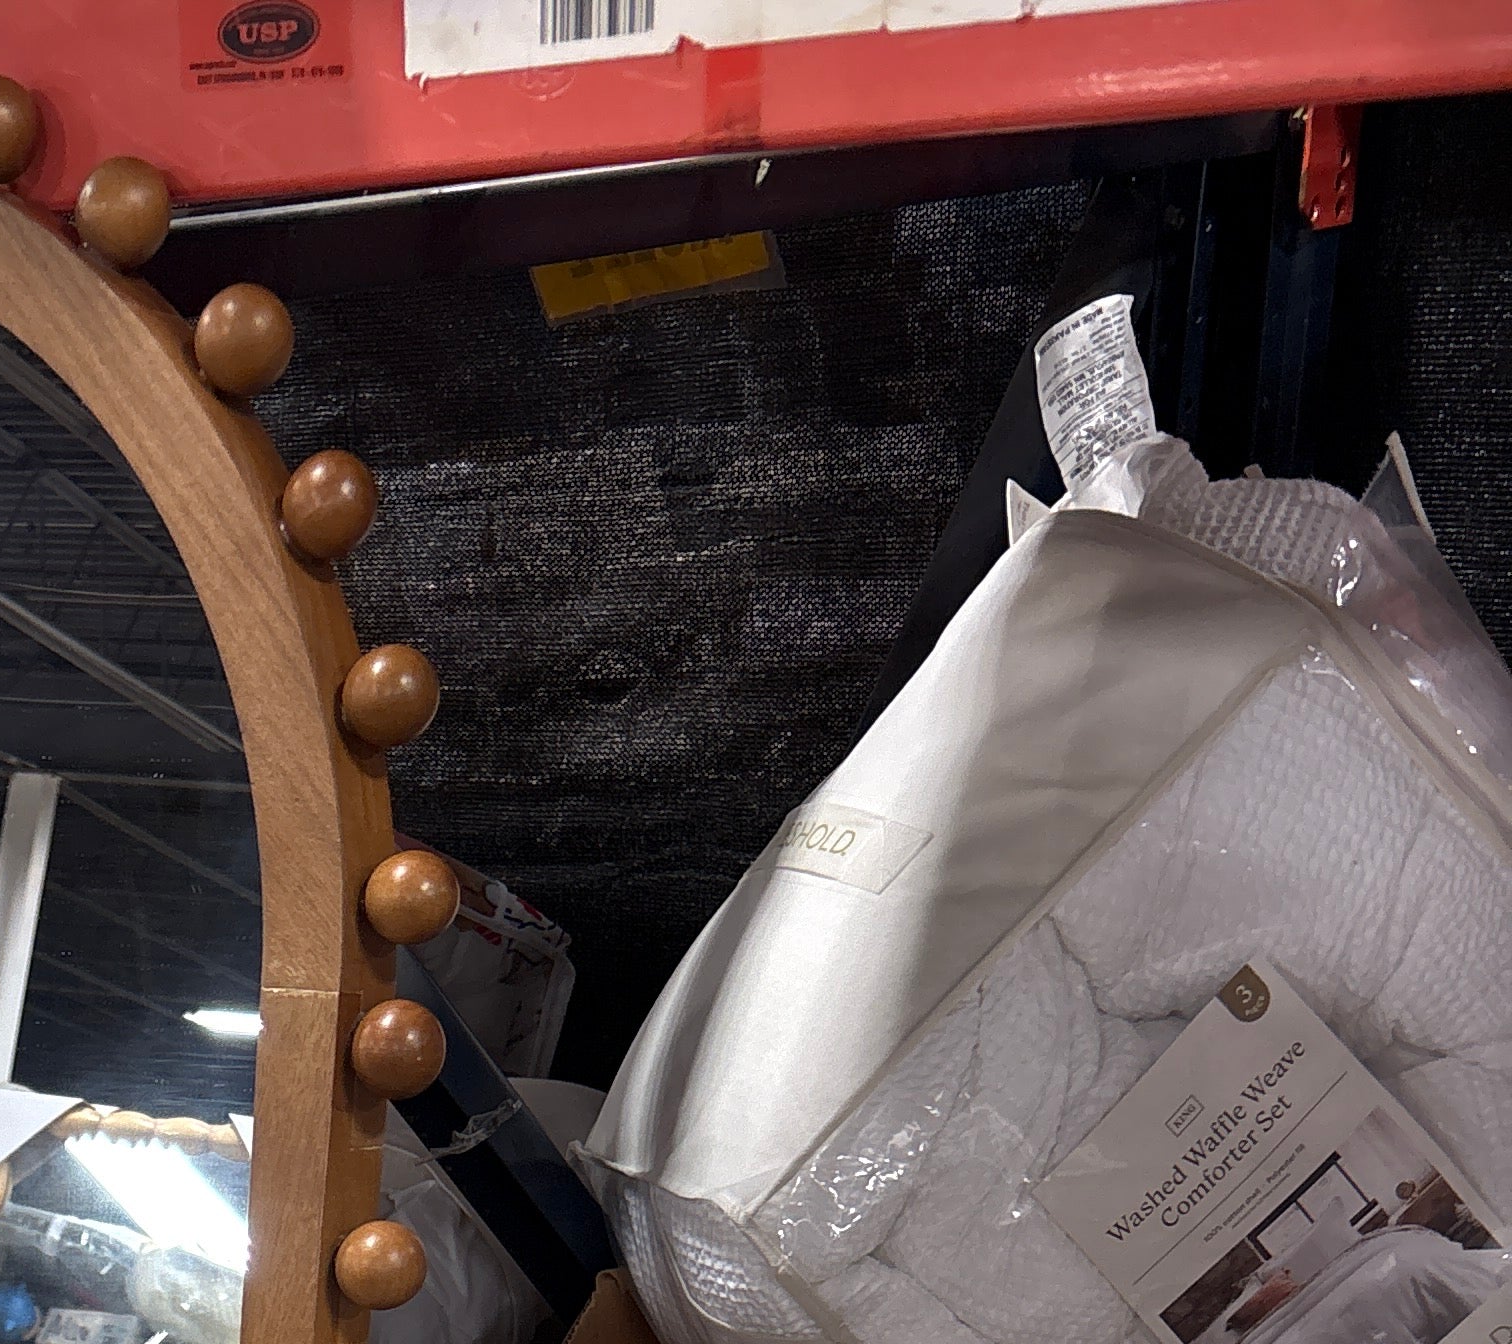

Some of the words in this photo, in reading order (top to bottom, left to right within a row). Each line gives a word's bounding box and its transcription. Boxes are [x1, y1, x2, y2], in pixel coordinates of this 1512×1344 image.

[238, 20, 298, 45] USP
[1234, 982, 1254, 1004] 3
[1171, 1102, 1198, 1130] KING
[1106, 1164, 1188, 1244] Washed
[1180, 1103, 1248, 1169] Waffle
[1241, 1039, 1306, 1105] Weave
[1160, 1127, 1261, 1229] Comforter
[1254, 1094, 1293, 1133] Set
